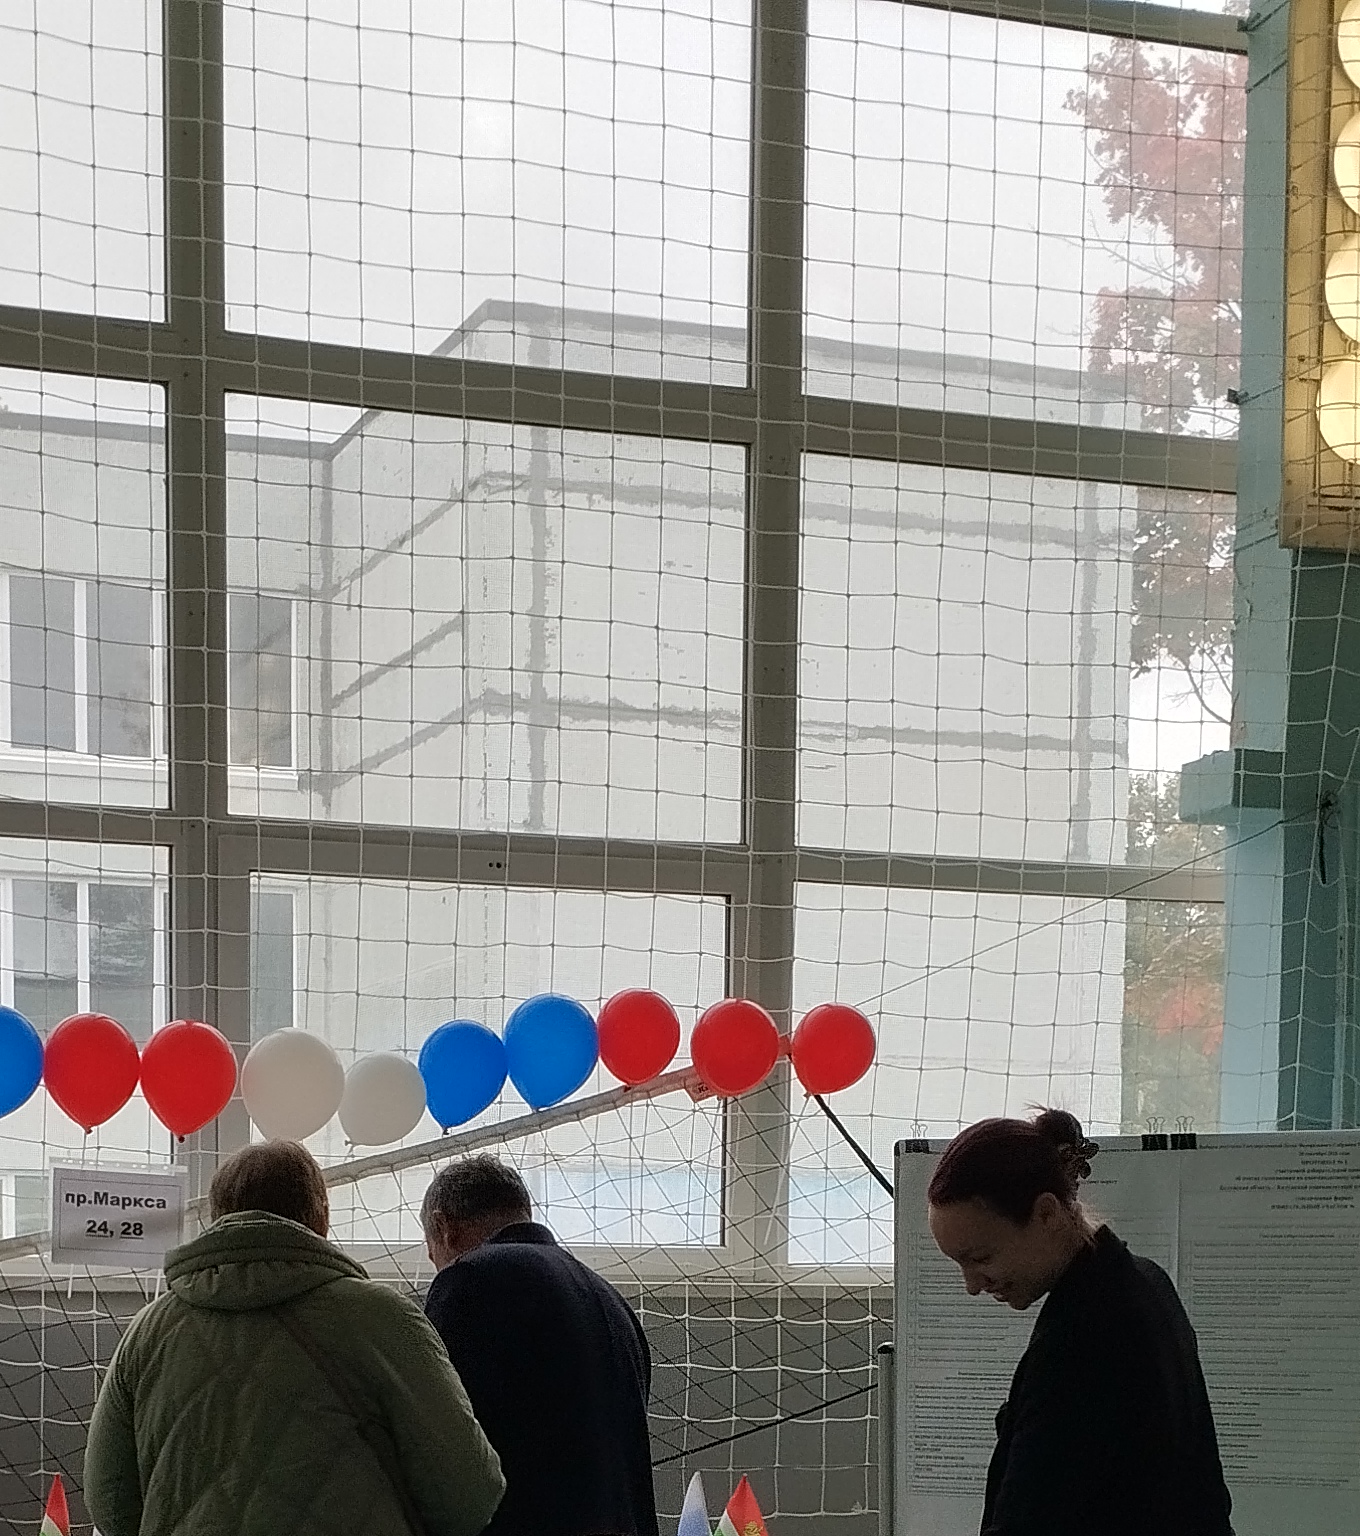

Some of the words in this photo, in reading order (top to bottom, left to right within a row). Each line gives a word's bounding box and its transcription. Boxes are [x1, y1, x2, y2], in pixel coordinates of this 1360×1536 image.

[64, 1190, 167, 1211] пр.Маркса
[85, 1219, 114, 1238] 24,
[120, 1220, 144, 1239] 28
